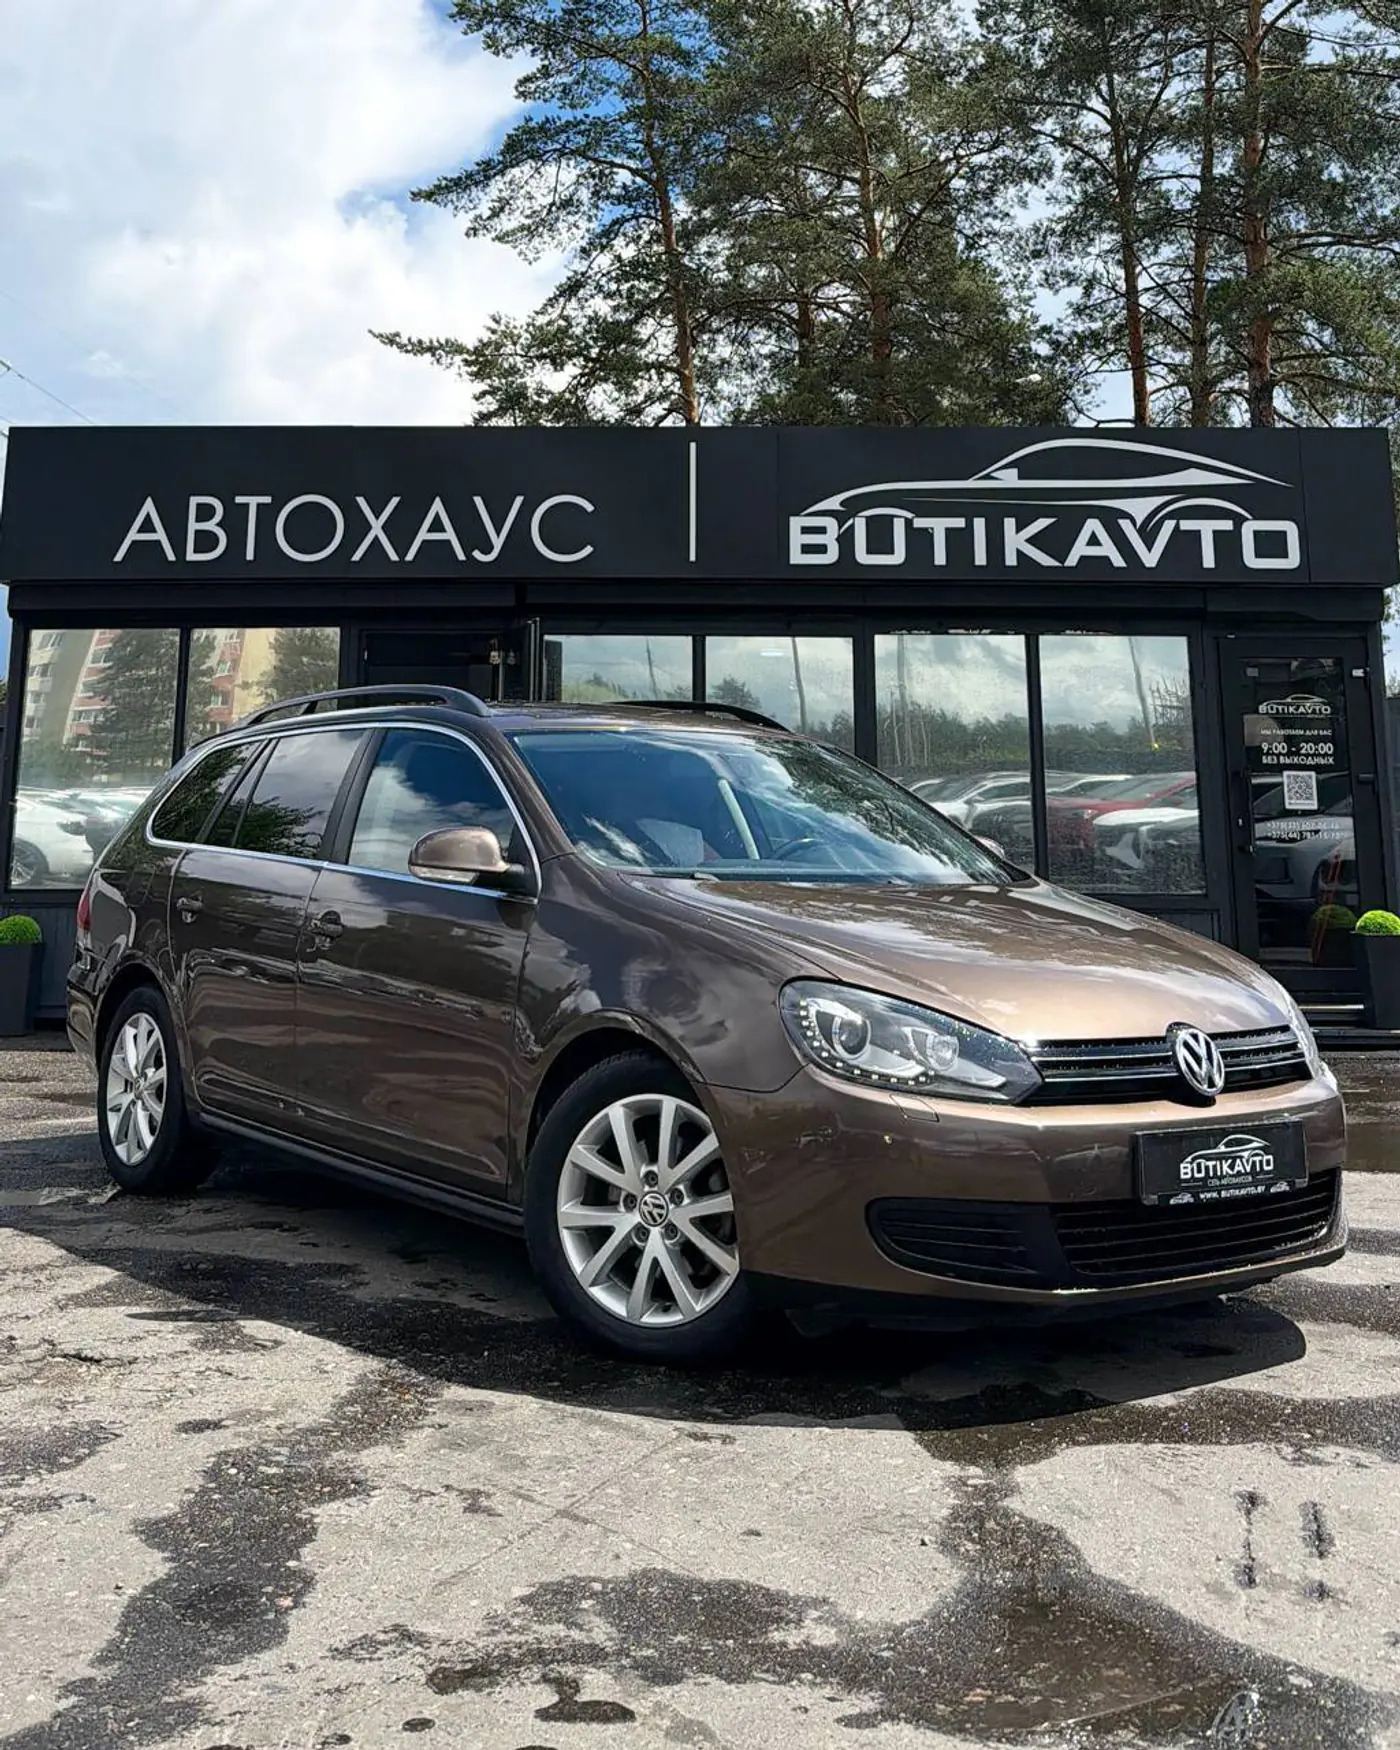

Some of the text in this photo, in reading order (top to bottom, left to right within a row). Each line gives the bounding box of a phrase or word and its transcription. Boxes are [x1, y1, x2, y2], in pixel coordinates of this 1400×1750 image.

[113, 494, 595, 563] АВТОХАУС
[788, 515, 1302, 571] BUTIKAVTO
[1258, 703, 1331, 715] BUTIKAVTO
[1261, 742, 1288, 754] 9:00
[1300, 742, 1334, 755] 20:00
[1262, 755, 1335, 765] БЕЗ ВЫХОДНЫХ
[1180, 1154, 1275, 1179] BUTIKAVTO
